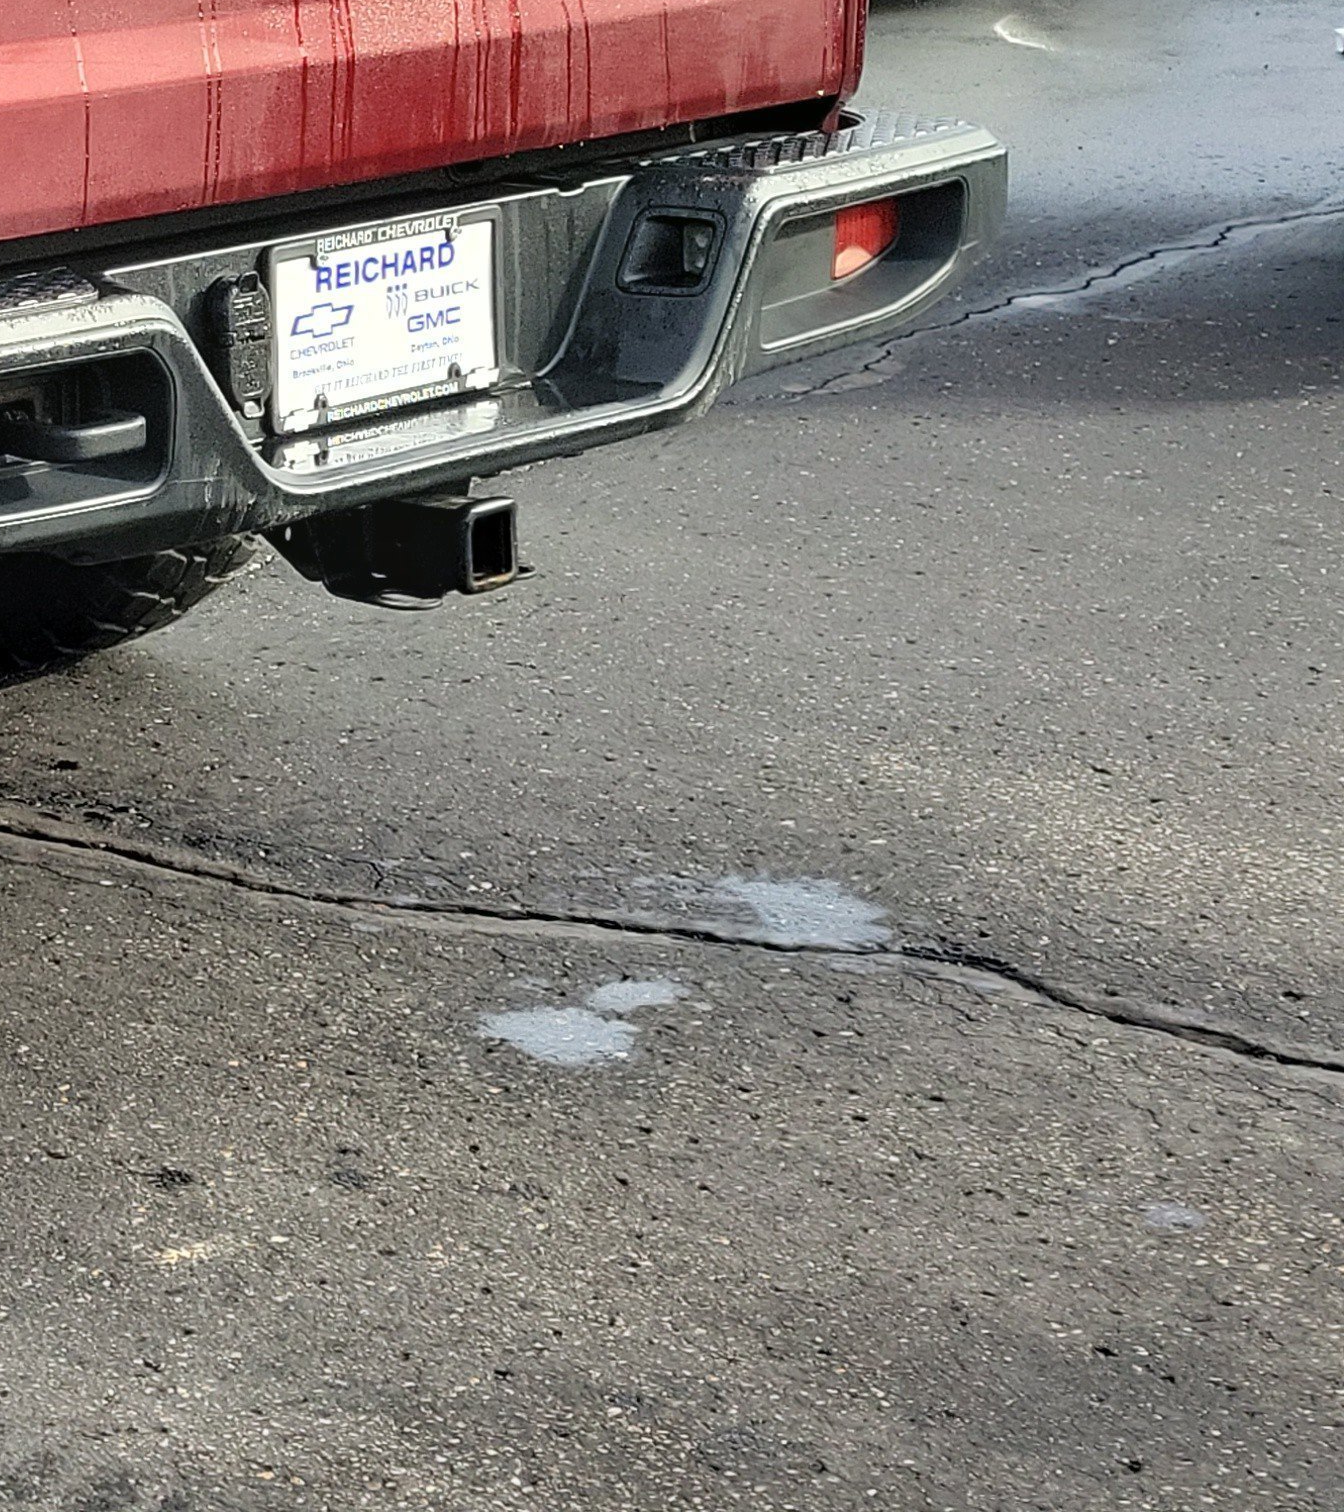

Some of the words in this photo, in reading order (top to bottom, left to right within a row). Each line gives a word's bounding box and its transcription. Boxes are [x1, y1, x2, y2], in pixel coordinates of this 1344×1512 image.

[317, 230, 373, 255] REICHARD
[378, 213, 460, 241] CHEVROLET
[315, 241, 455, 293] REICHARD
[414, 279, 481, 303] BUICK
[407, 306, 461, 332] GMC
[289, 336, 356, 361] CHEVROLET
